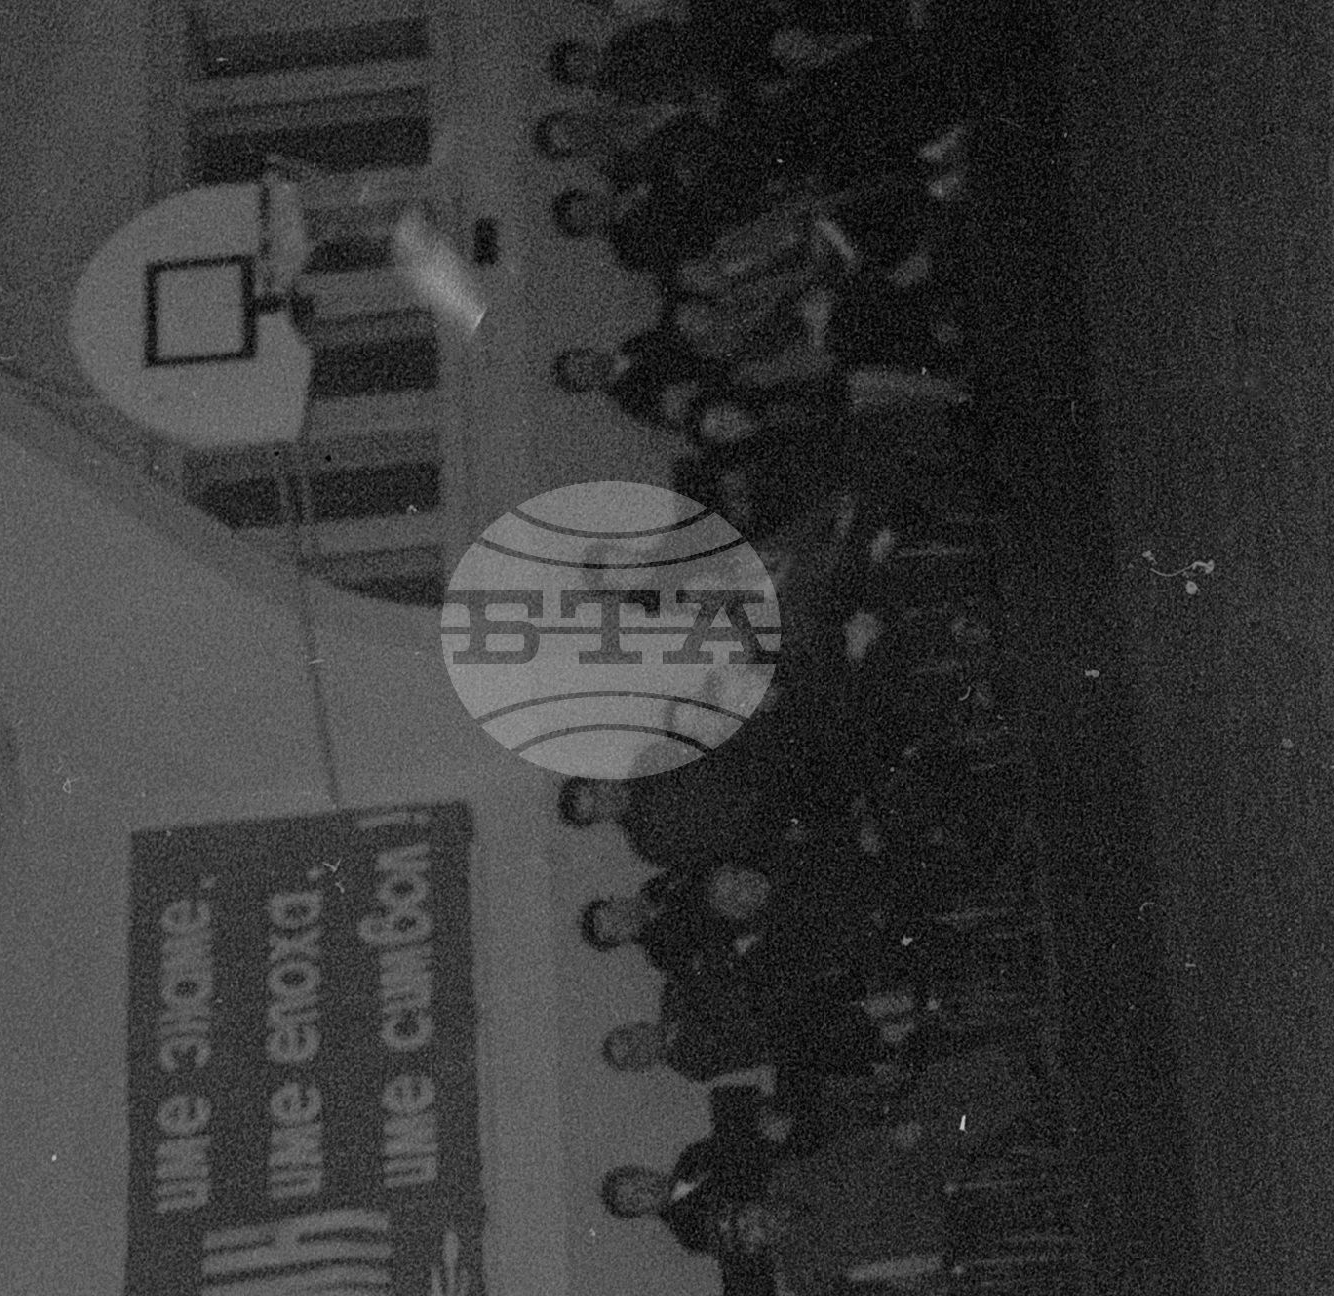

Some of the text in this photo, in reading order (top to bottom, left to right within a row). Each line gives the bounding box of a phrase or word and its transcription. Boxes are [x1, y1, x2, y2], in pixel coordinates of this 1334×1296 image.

[153, 1094, 212, 1216] име
[267, 1081, 324, 1199] име
[381, 1073, 437, 1189] име
